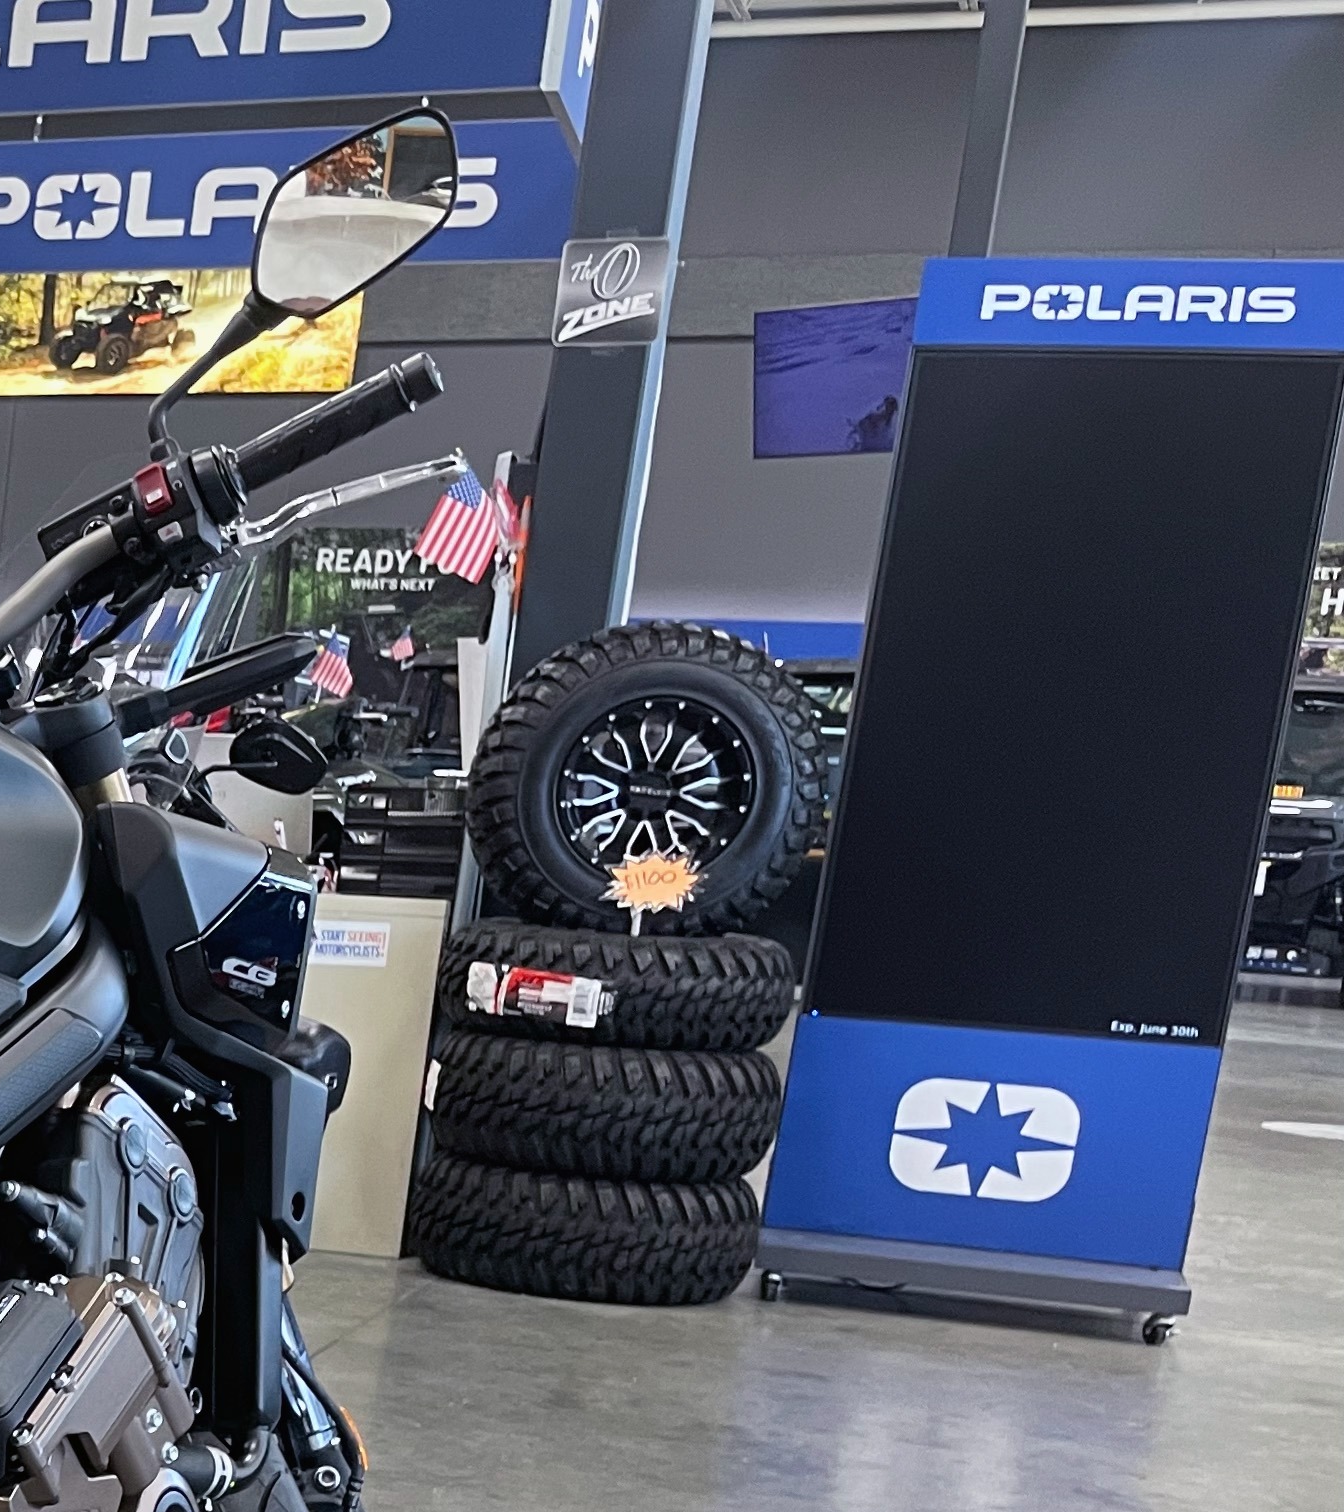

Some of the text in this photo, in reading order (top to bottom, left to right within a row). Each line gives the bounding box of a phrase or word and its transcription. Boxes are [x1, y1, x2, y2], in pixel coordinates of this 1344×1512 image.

[981, 283, 1296, 324] POLARIS
[316, 547, 413, 575] READY
[350, 577, 437, 592] WHAT'S NEXT
[321, 929, 347, 942] START
[1138, 1023, 1168, 1036] June
[1170, 1025, 1199, 1038] 30th
